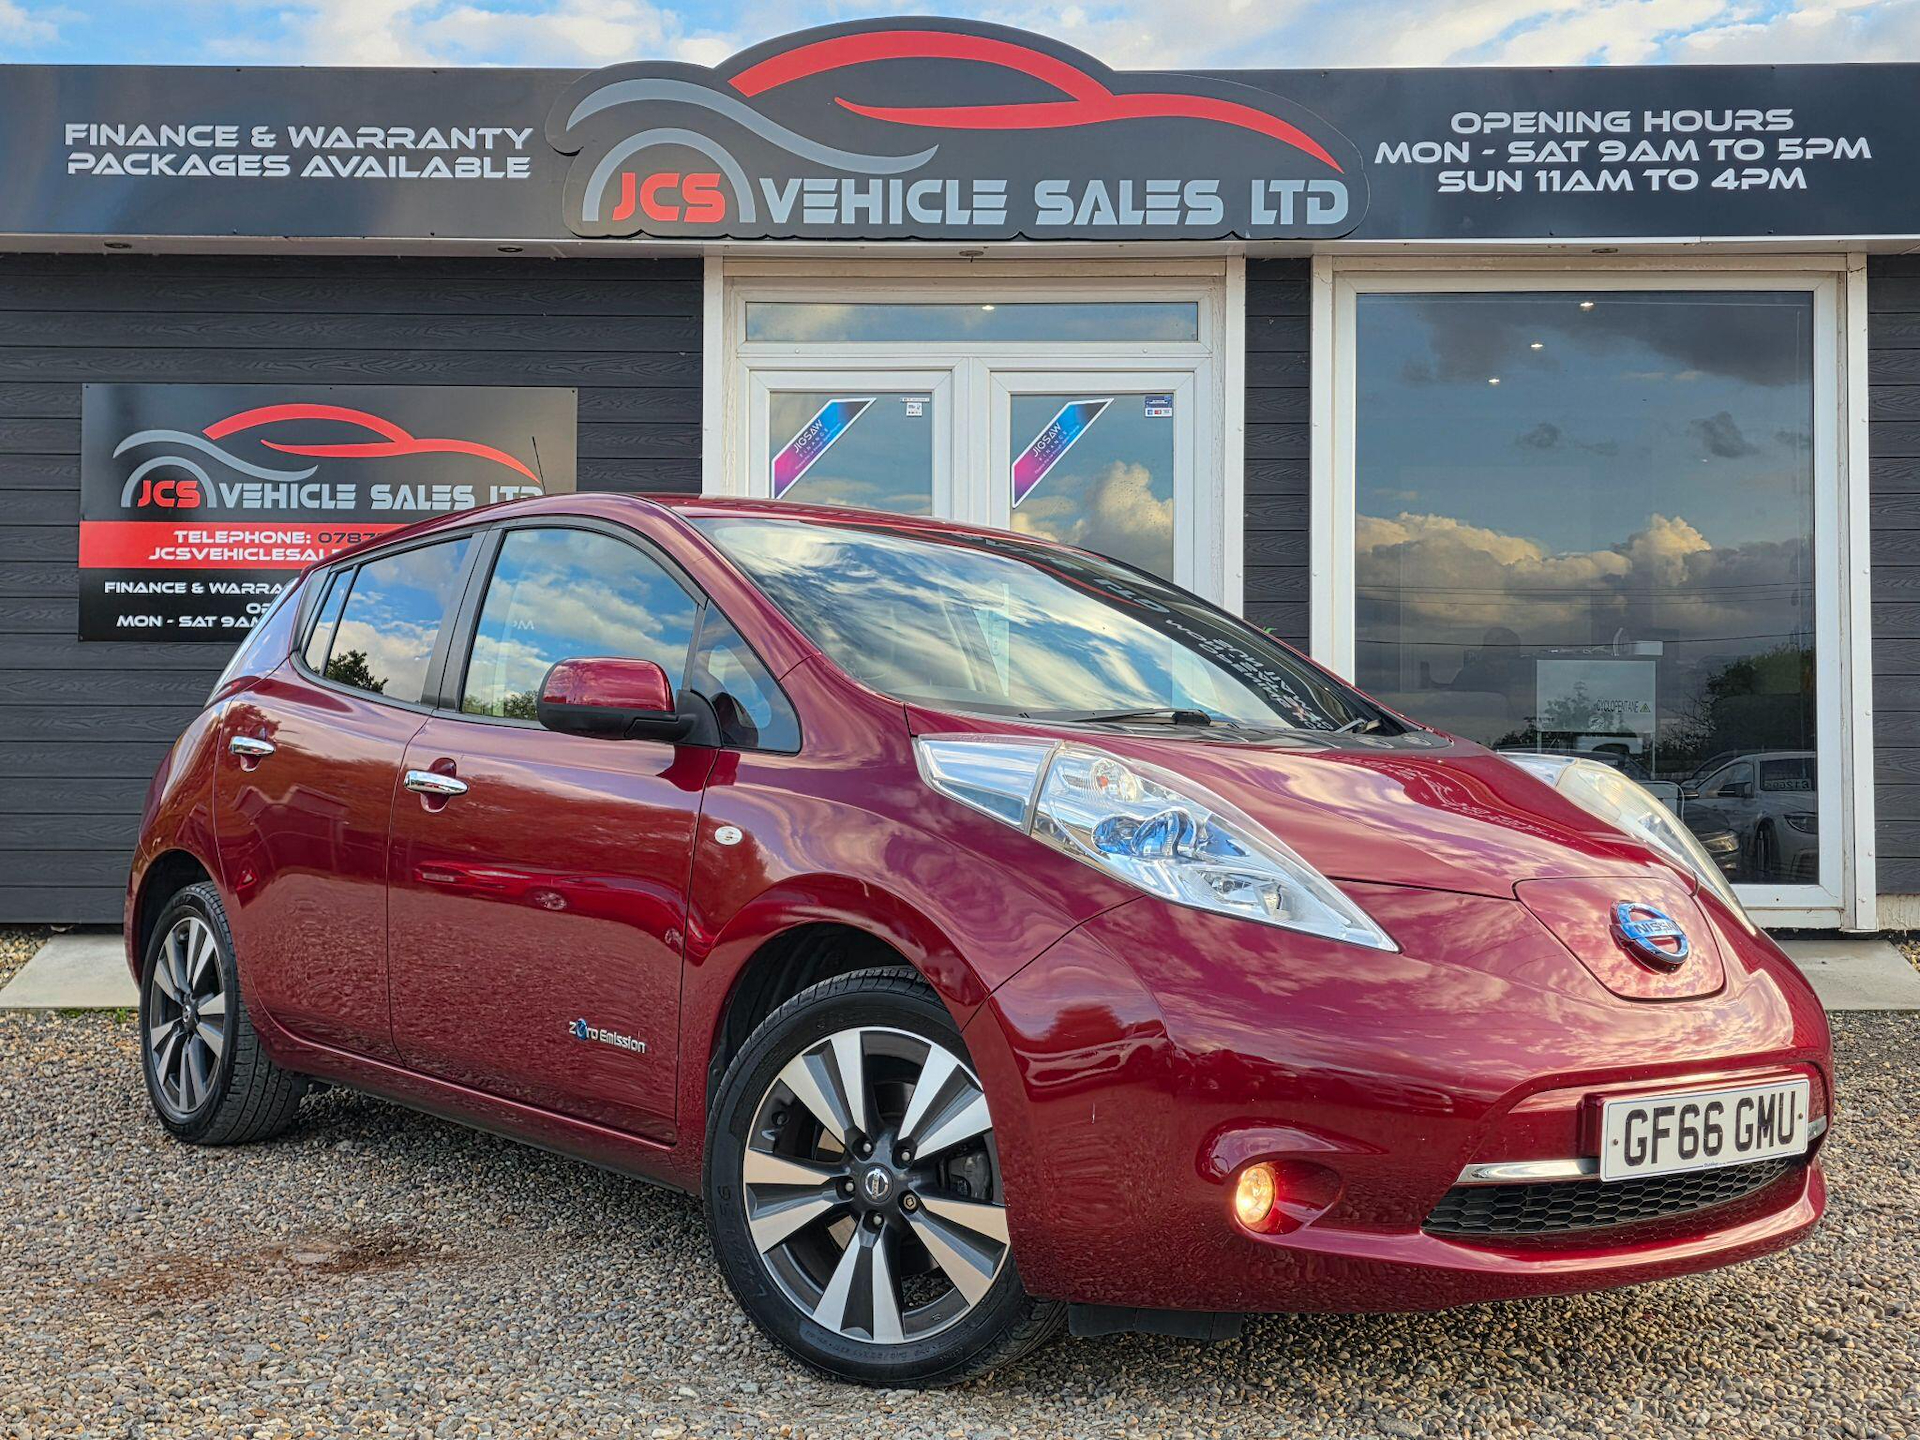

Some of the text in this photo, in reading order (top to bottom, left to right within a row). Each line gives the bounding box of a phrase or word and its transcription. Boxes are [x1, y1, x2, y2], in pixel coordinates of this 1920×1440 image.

[1450, 108, 1794, 134] OPENING HOURS
[65, 123, 534, 150] FINANCE & WARRANTY
[1374, 141, 1470, 164] MON
[1507, 140, 1590, 163] SAT
[1598, 139, 1700, 163] 9AM
[1708, 138, 1765, 161] TO
[1777, 136, 1872, 160] 5PM
[67, 152, 531, 179] PACKAGES AVAILABLE
[1437, 167, 1808, 193] SUN 11AM TO 4PM
[612, 171, 1349, 226] JCS VEHICLE SALES LTD
[794, 419, 822, 453] JIGSAW
[1032, 422, 1061, 457] JIGSAW
[137, 480, 201, 509] JCS
[219, 483, 357, 510] VEHICLE
[370, 484, 476, 511] SALES
[173, 530, 311, 545] TELEPHONE:
[104, 581, 187, 595] FINANCE
[191, 582, 204, 595] &
[116, 615, 163, 628] MON
[178, 615, 218, 628] SAT
[1634, 921, 1681, 934] NISSAN
[600, 1029, 646, 1054] Emission
[1623, 1090, 1796, 1167] GF66 GMU
